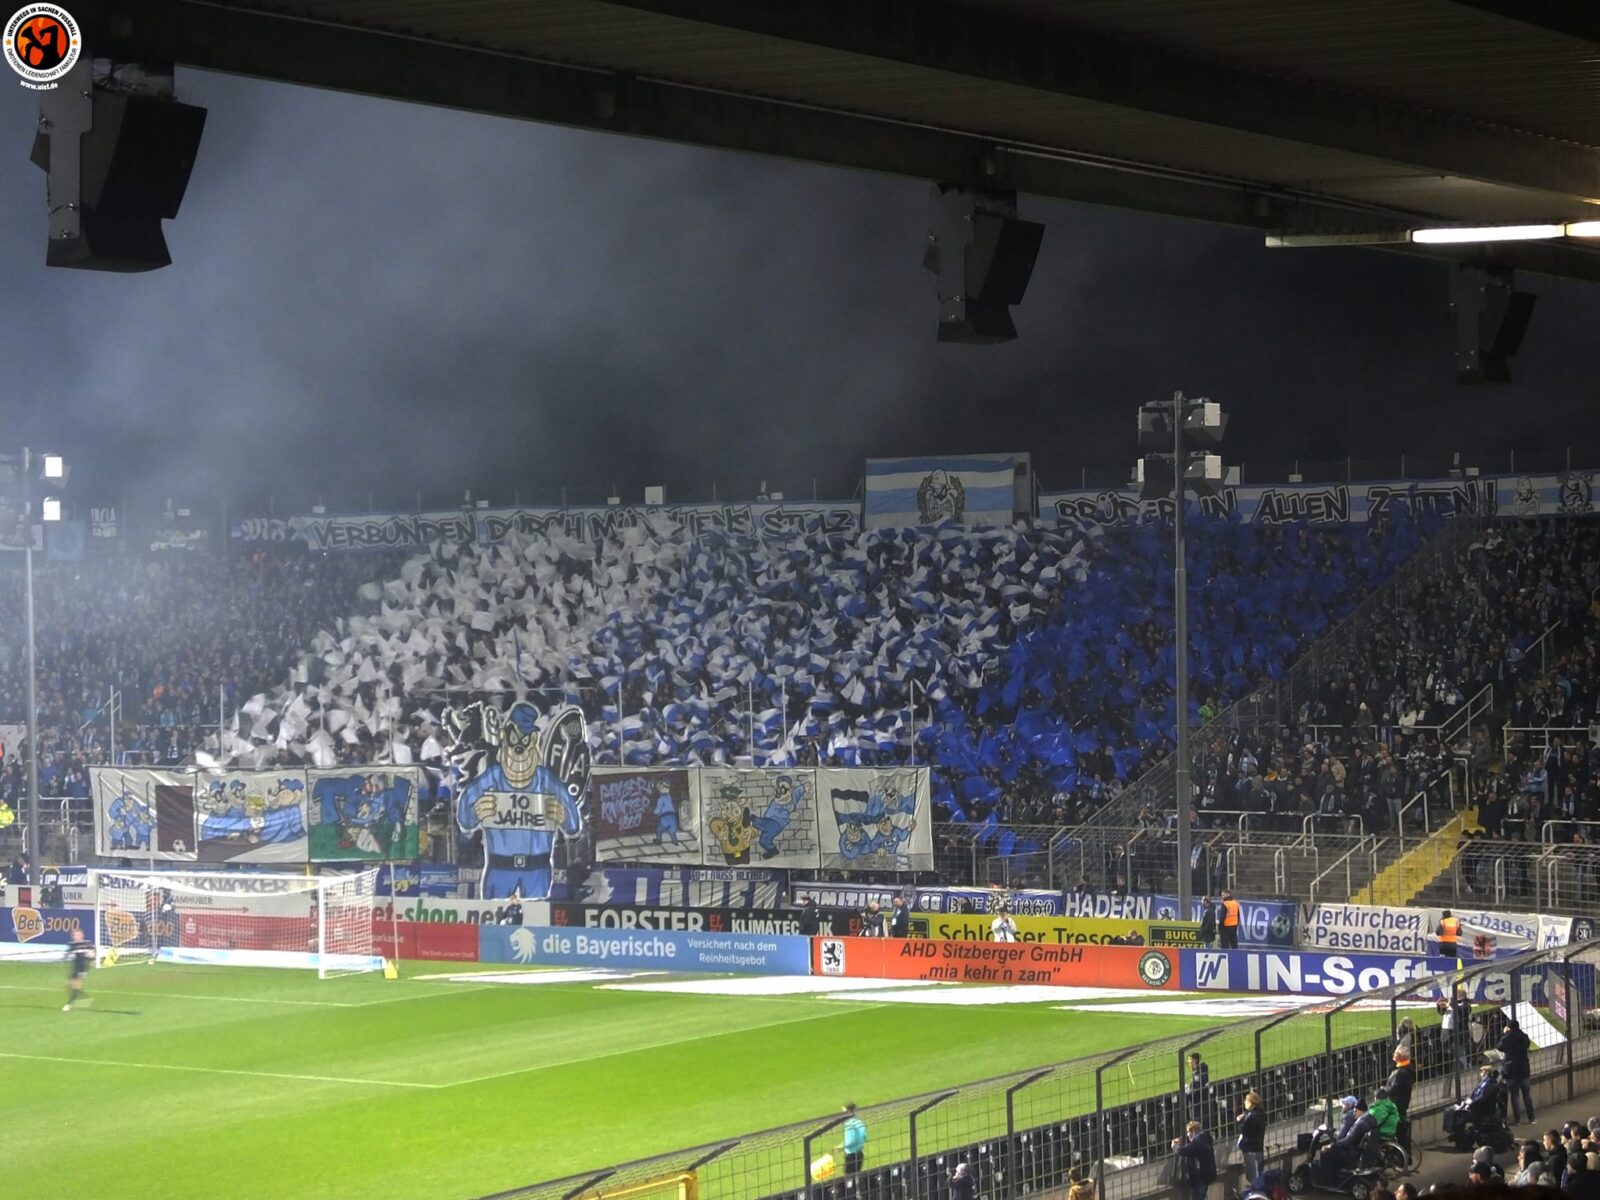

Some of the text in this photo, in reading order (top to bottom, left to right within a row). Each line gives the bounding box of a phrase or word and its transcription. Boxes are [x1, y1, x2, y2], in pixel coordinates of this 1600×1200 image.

[1251, 483, 1350, 525] ALLEN
[308, 512, 477, 549] VERBUNDEN
[511, 795, 529, 809] 10
[494, 811, 545, 826] JAHRE
[371, 899, 504, 925] et-shop.net
[1016, 899, 1055, 915] 1860
[1065, 893, 1151, 920] HADERN
[1302, 903, 1421, 930] Vierkirchen
[17, 914, 80, 932] Bet 3000
[585, 909, 704, 932] FORSTER
[687, 937, 777, 951] Versichert nach dem
[939, 923, 1046, 943] Schlöser
[1053, 927, 1117, 945] Treso
[1165, 930, 1197, 940] BURG
[1315, 926, 1425, 951] Pasenbach
[542, 934, 677, 958] die Bayerische
[900, 942, 1083, 962] AHD Sitzberger GmbH
[699, 952, 766, 966] Reinheitsgebot
